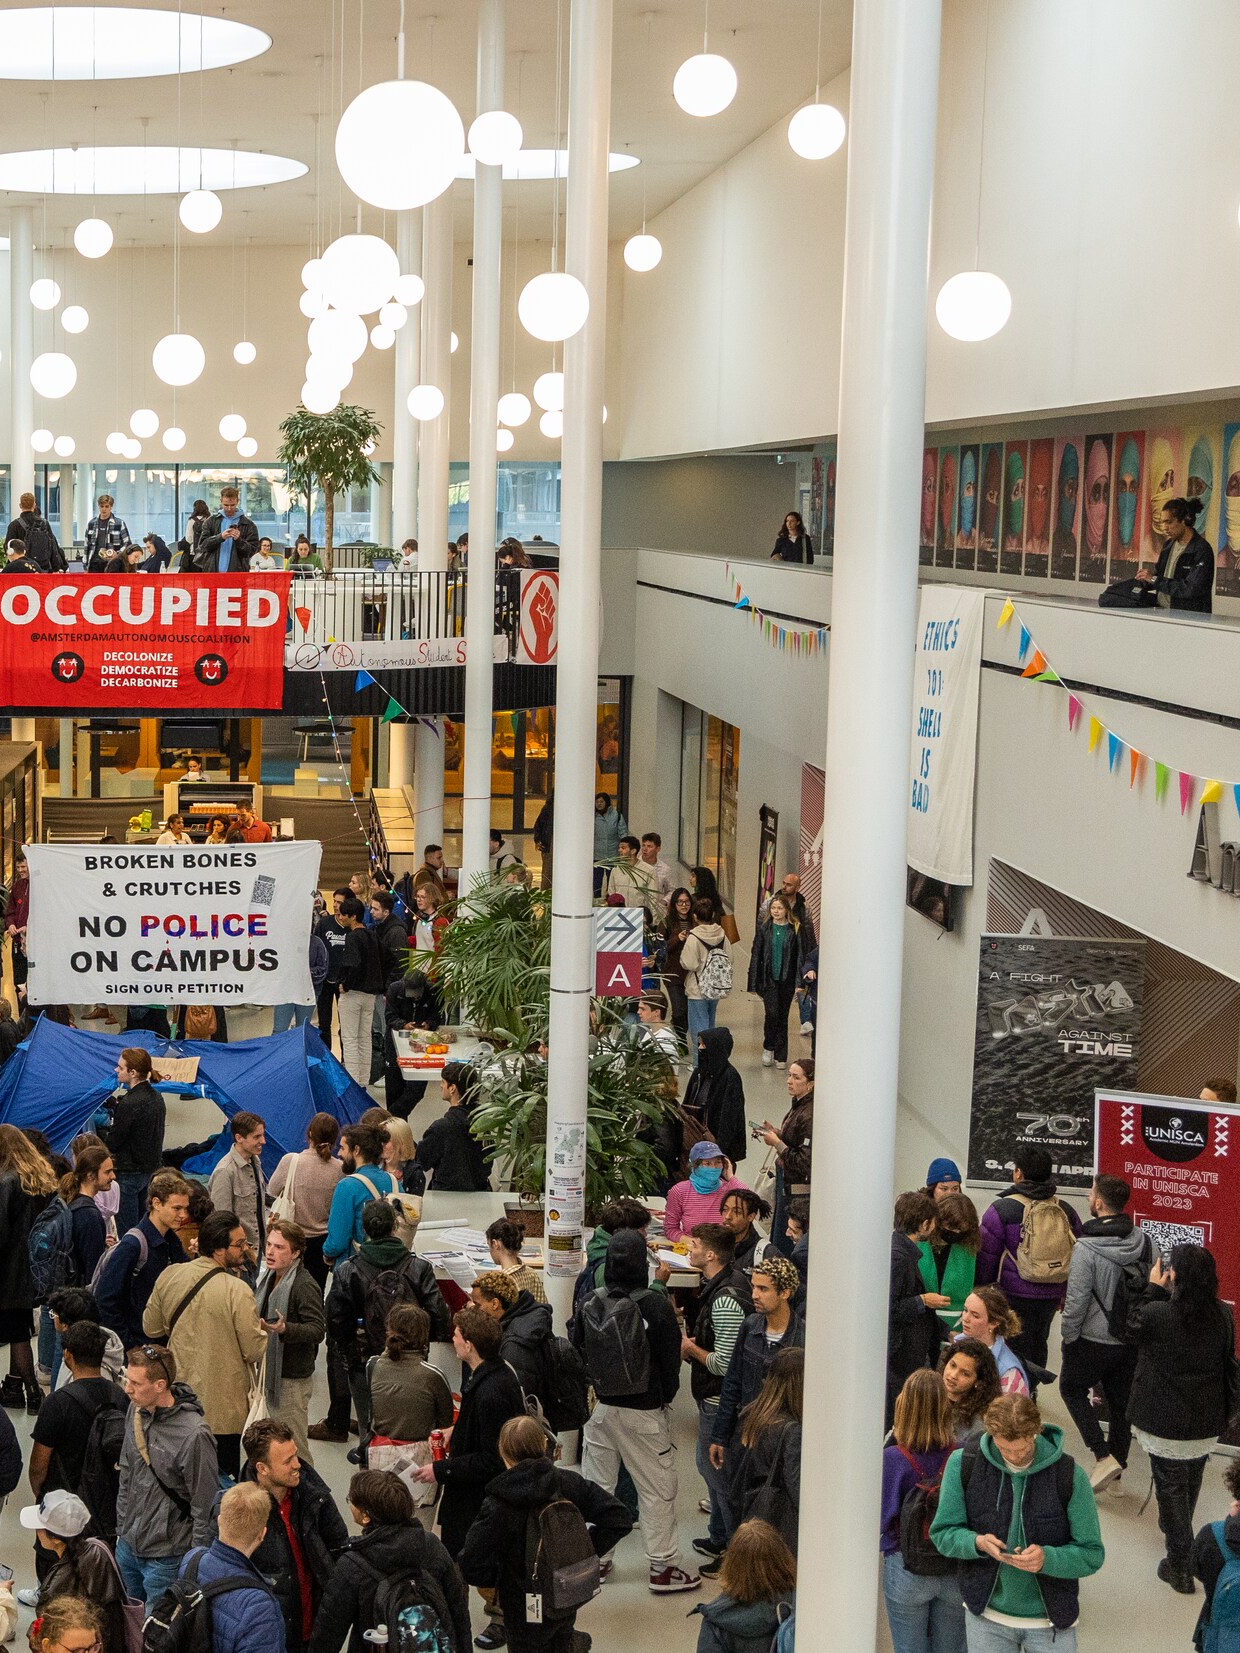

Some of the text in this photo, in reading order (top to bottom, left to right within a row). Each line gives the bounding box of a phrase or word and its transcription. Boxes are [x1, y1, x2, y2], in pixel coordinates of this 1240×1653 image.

[0, 584, 280, 628] OCCUPIED
[30, 631, 251, 645] @AMSTERDAMAUTONOMOUSCOALITION
[922, 617, 961, 652] ETHICS
[103, 651, 174, 662] DECOLONIZE
[100, 664, 179, 676] DEMOCRATIZE
[100, 677, 178, 689] DECARBONIZE
[917, 706, 943, 738] SHELL
[919, 747, 931, 780] IS
[911, 778, 930, 814] BAD
[84, 852, 257, 871] BROKEN BONES
[102, 880, 242, 897] & CRUTCHES
[78, 913, 269, 939] NO POLICE
[69, 948, 280, 973] ON CAMPUS
[607, 963, 631, 988] A
[989, 971, 1063, 983] A FIGHT
[104, 983, 244, 995] SIGN OUR PETITION
[1057, 1029, 1134, 1042] AGAINST
[1057, 1039, 1133, 1058] TIME
[1015, 1136, 1089, 1146] ANNIVERSARY
[1148, 1126, 1205, 1143] UNISCA
[1124, 1161, 1219, 1185] PARTICIPATE
[1132, 1176, 1210, 1198] IN UNISCA
[1152, 1194, 1193, 1210] 2023
